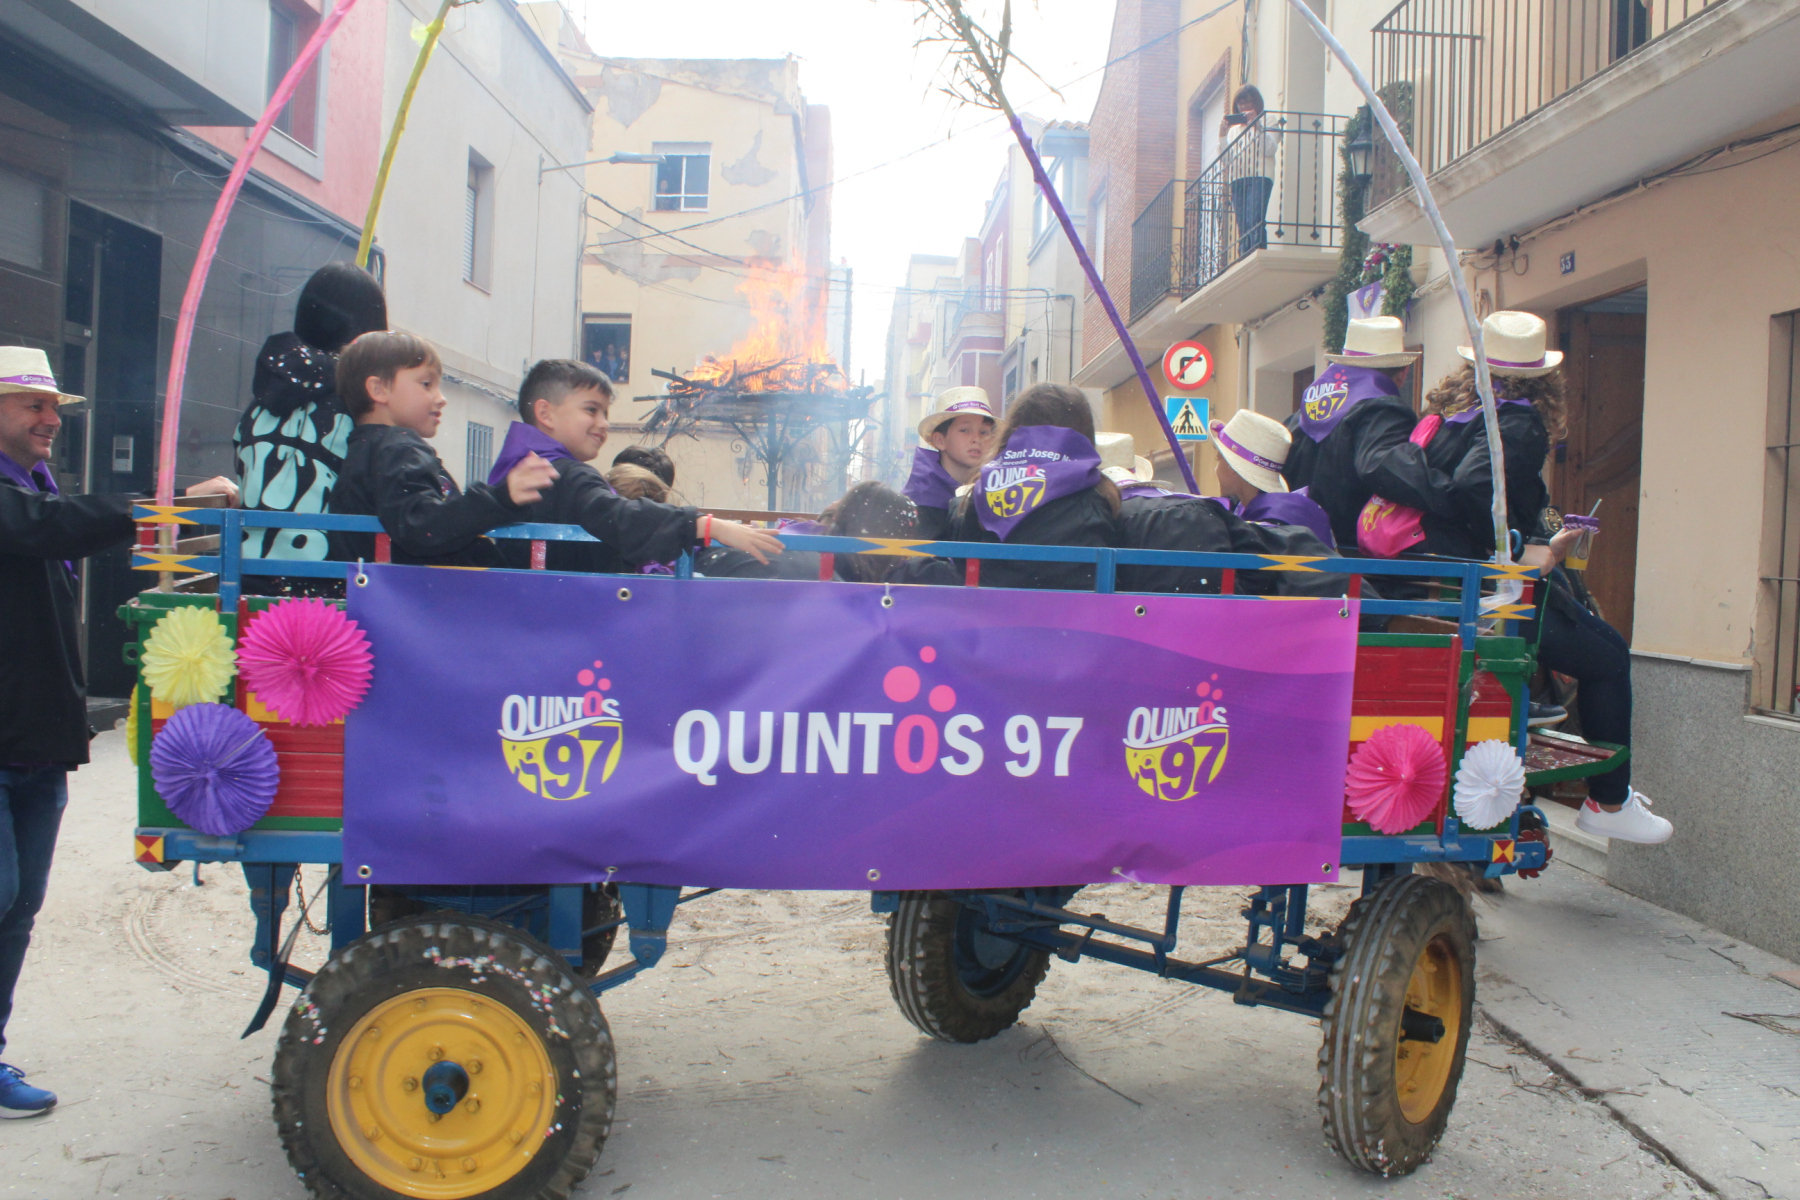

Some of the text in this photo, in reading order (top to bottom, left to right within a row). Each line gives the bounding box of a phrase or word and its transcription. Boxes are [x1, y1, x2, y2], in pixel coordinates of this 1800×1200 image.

[1305, 380, 1349, 402] QUINTOS
[1317, 392, 1348, 420] 97
[1004, 448, 1028, 460] Sant
[1028, 448, 1061, 462] Josep
[985, 464, 1047, 491] QUINTOS
[1003, 479, 1046, 517] 97
[499, 690, 621, 740] QUINTOS
[1124, 701, 1228, 748] QUINTOS
[542, 723, 621, 800] 97
[672, 709, 1084, 786] QUINTOS 97
[1159, 730, 1229, 801] 97
